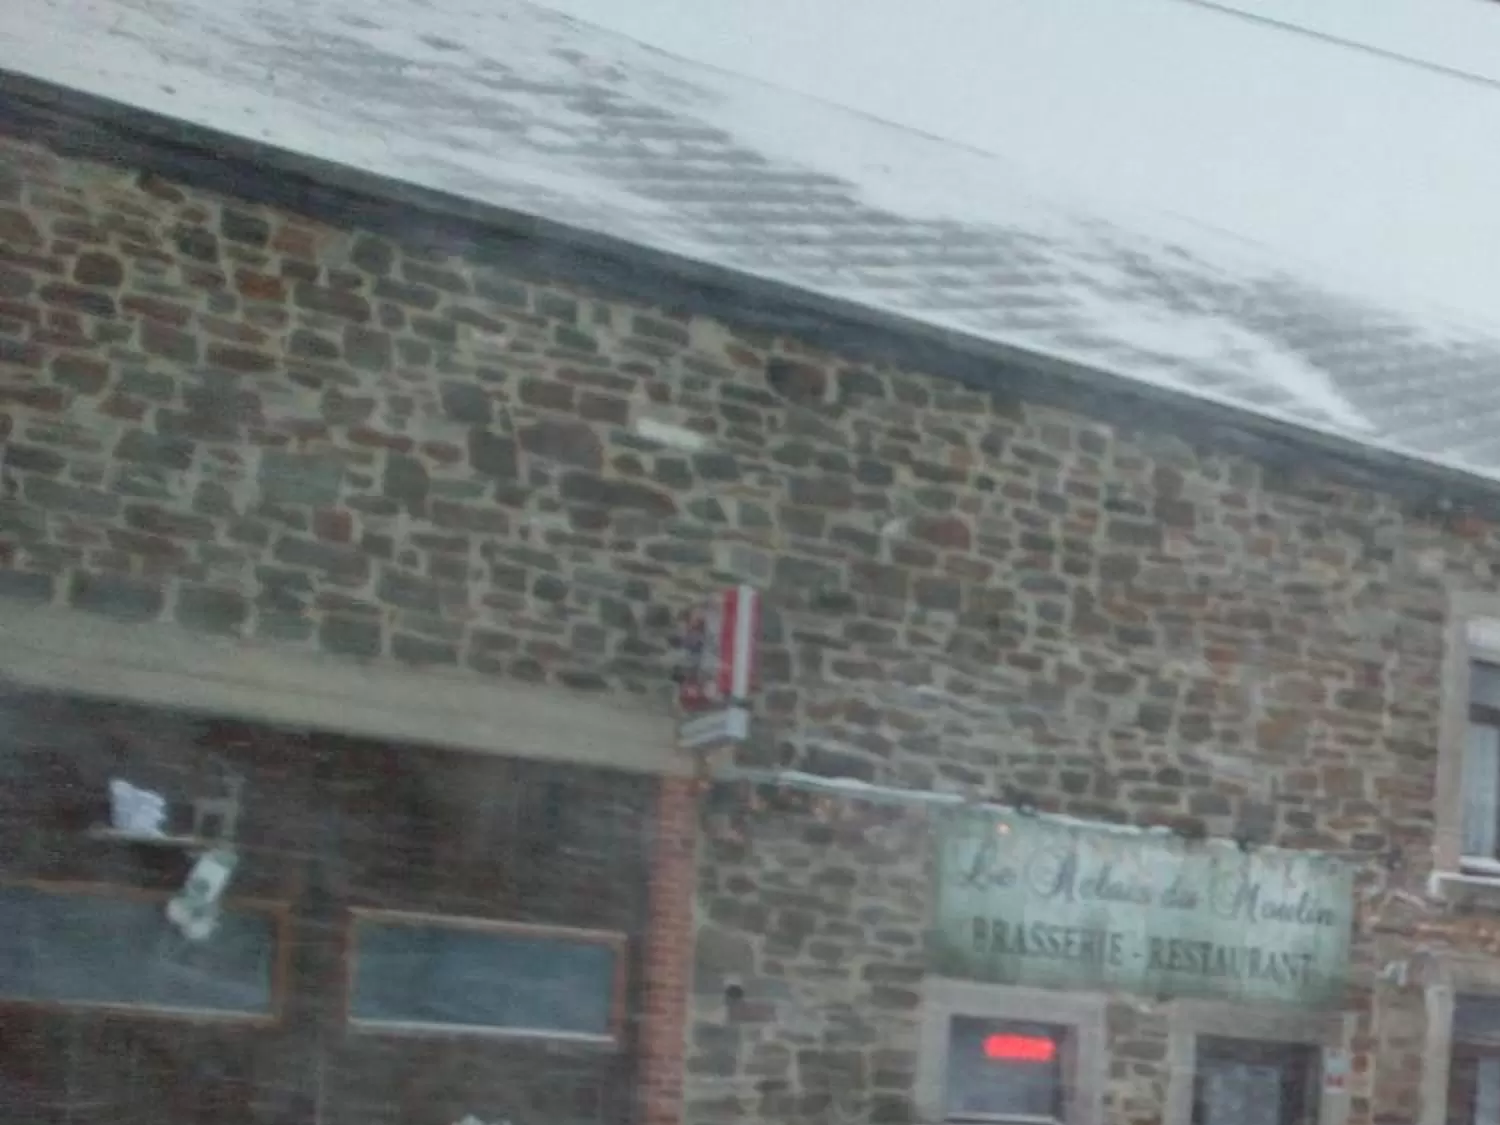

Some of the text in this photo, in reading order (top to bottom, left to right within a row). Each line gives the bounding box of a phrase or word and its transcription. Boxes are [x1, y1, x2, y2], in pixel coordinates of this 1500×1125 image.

[1211, 866, 1336, 926] Moulin
[972, 915, 1124, 966] BRASSERIE
[1148, 935, 1313, 986] RESTAURANT
